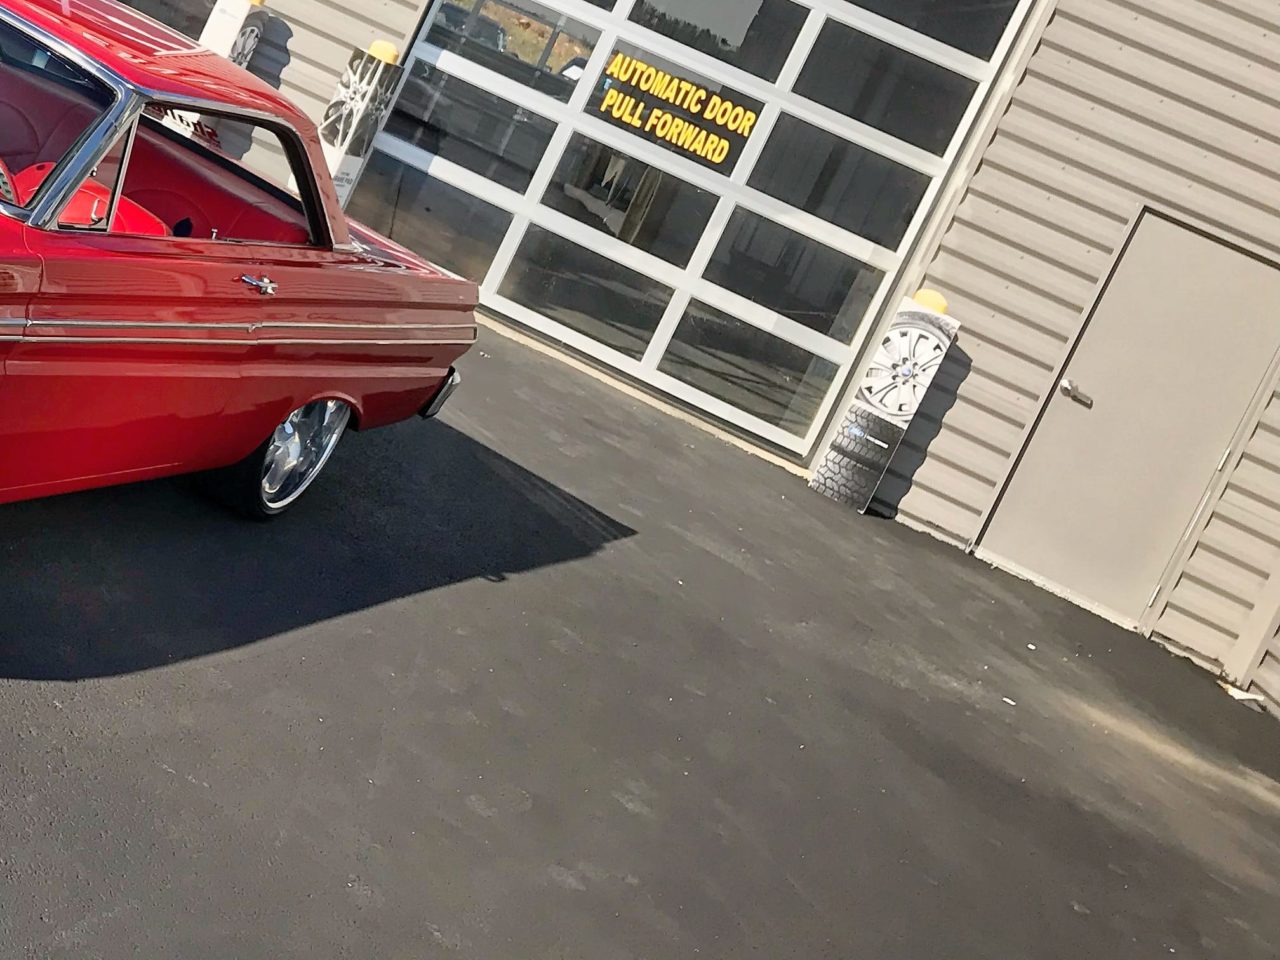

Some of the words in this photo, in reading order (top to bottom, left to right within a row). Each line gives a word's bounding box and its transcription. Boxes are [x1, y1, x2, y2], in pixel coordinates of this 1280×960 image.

[600, 88, 645, 127] PULL
[644, 108, 730, 164] FORWARD
[605, 53, 707, 113] AUTOMATIC
[703, 94, 756, 137] DOOR
